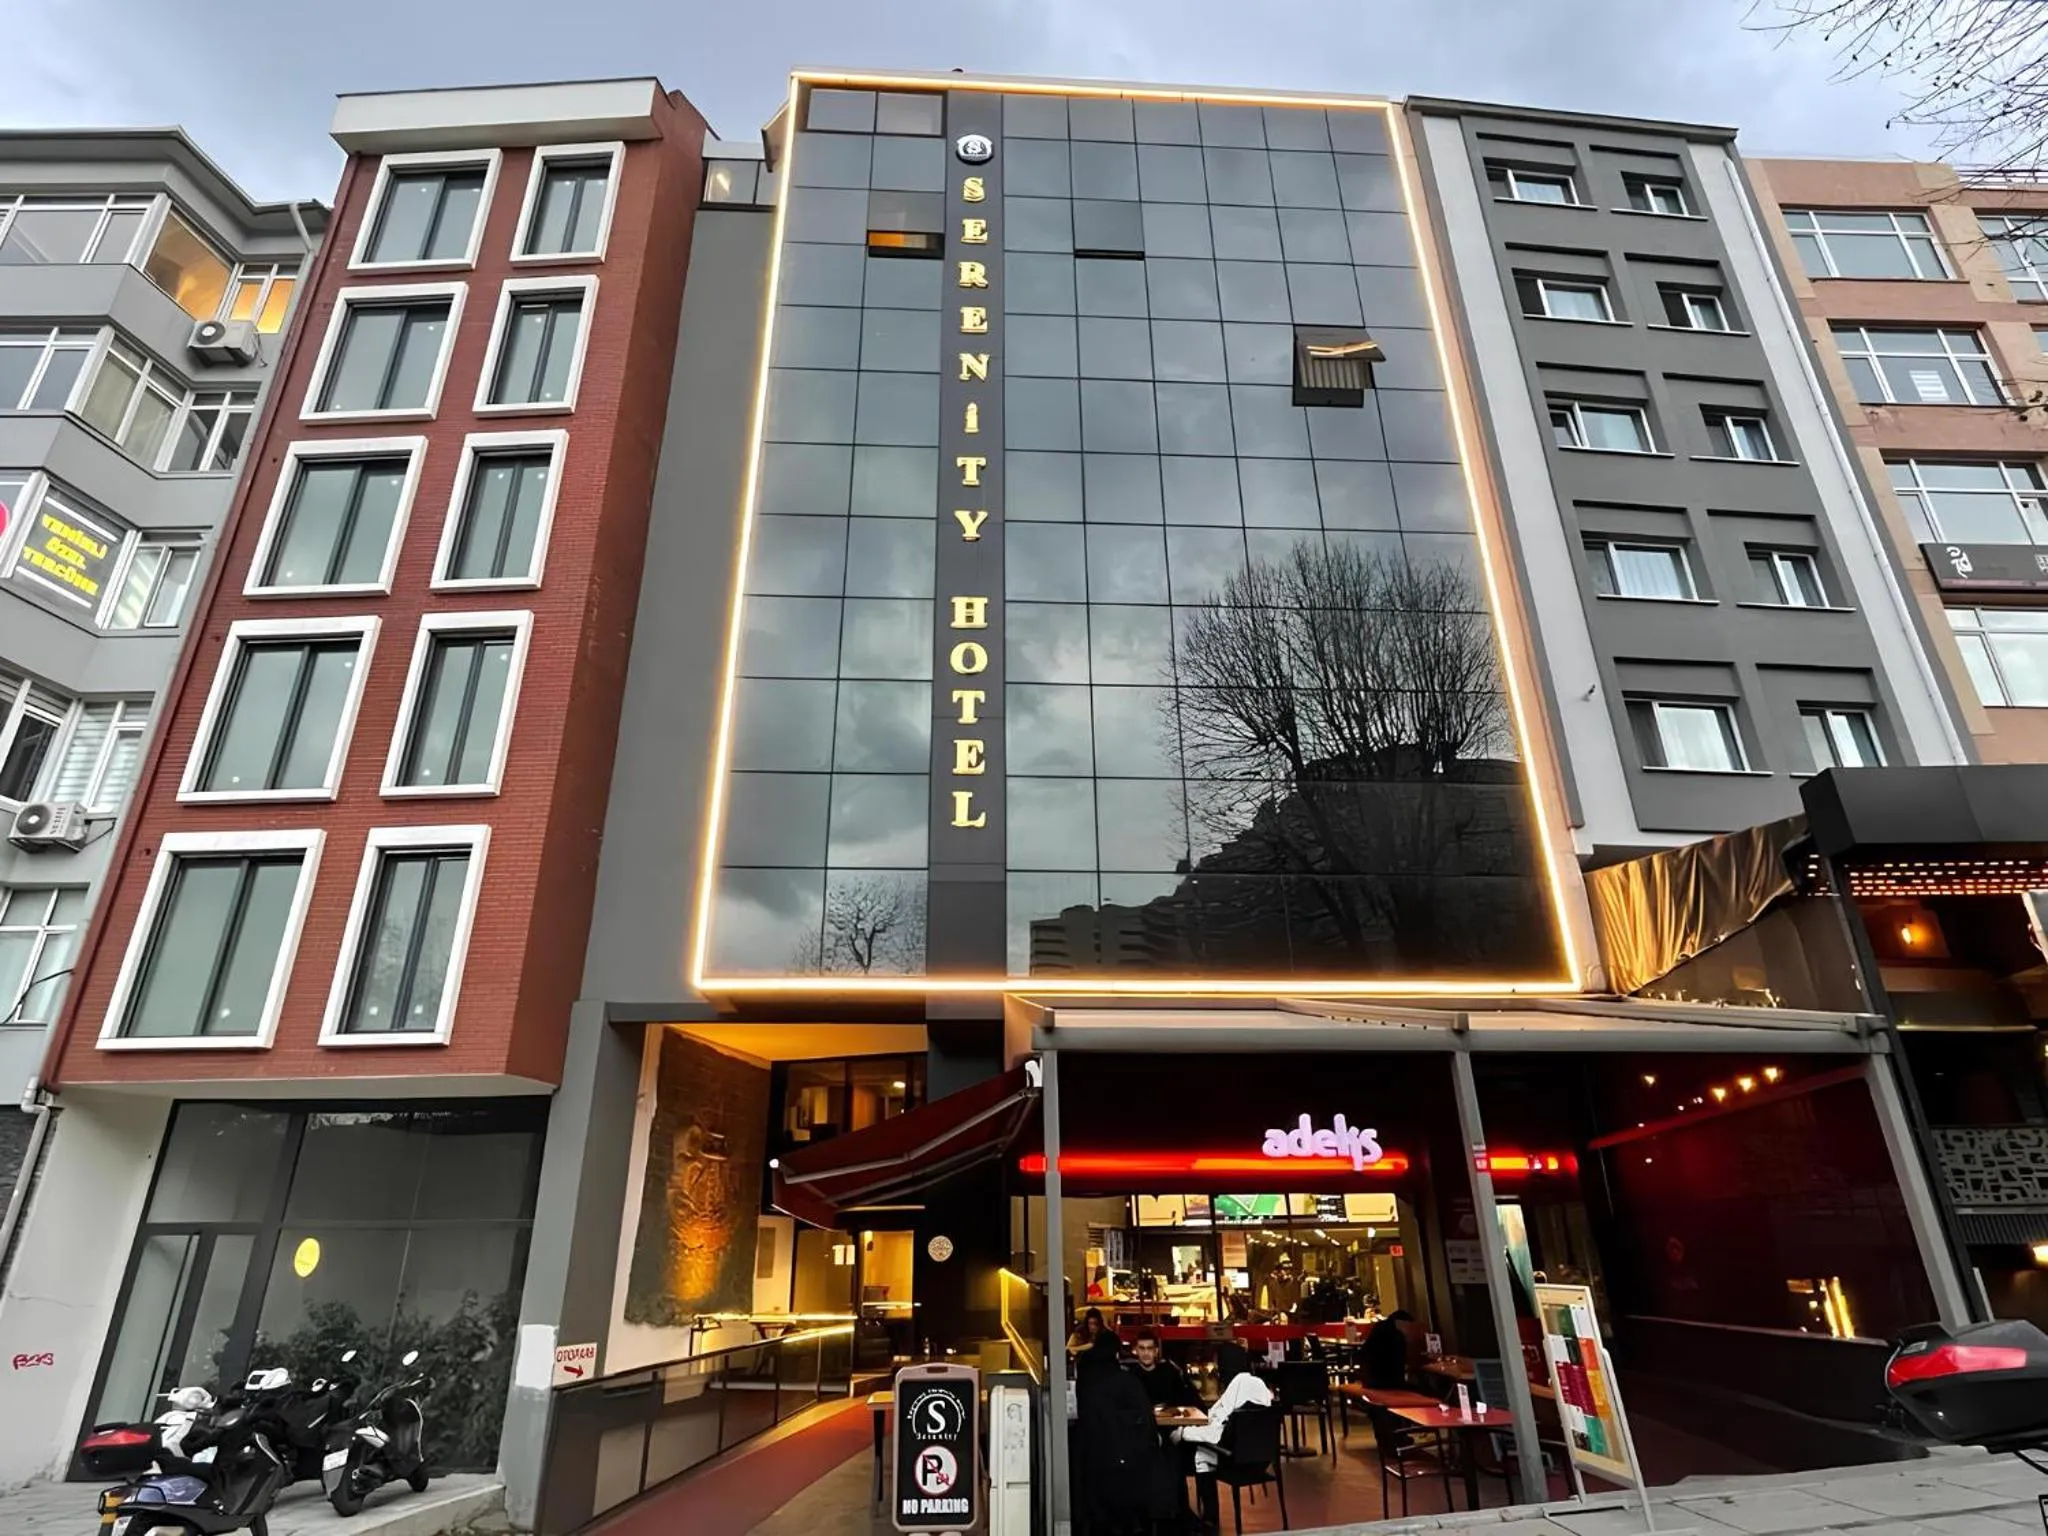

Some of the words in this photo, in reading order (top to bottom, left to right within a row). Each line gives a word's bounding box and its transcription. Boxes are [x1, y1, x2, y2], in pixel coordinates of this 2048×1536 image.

[950, 596, 989, 828] HOTEL
[902, 1499, 918, 1514] NO
[920, 1497, 969, 1514] PARKING
